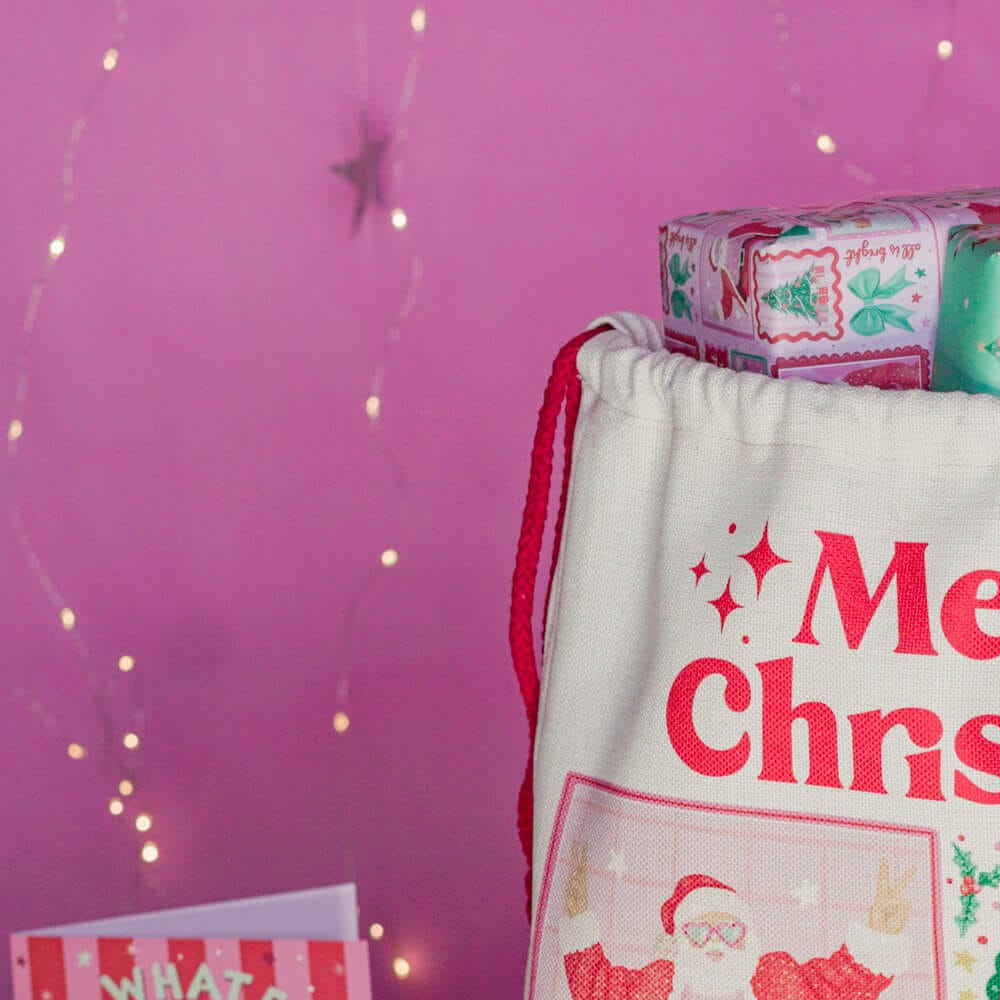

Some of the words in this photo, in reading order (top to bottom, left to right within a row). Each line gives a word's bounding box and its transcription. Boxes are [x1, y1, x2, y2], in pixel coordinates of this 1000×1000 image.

[844, 240, 887, 266] bright
[890, 246, 901, 257] is
[901, 244, 921, 260] all
